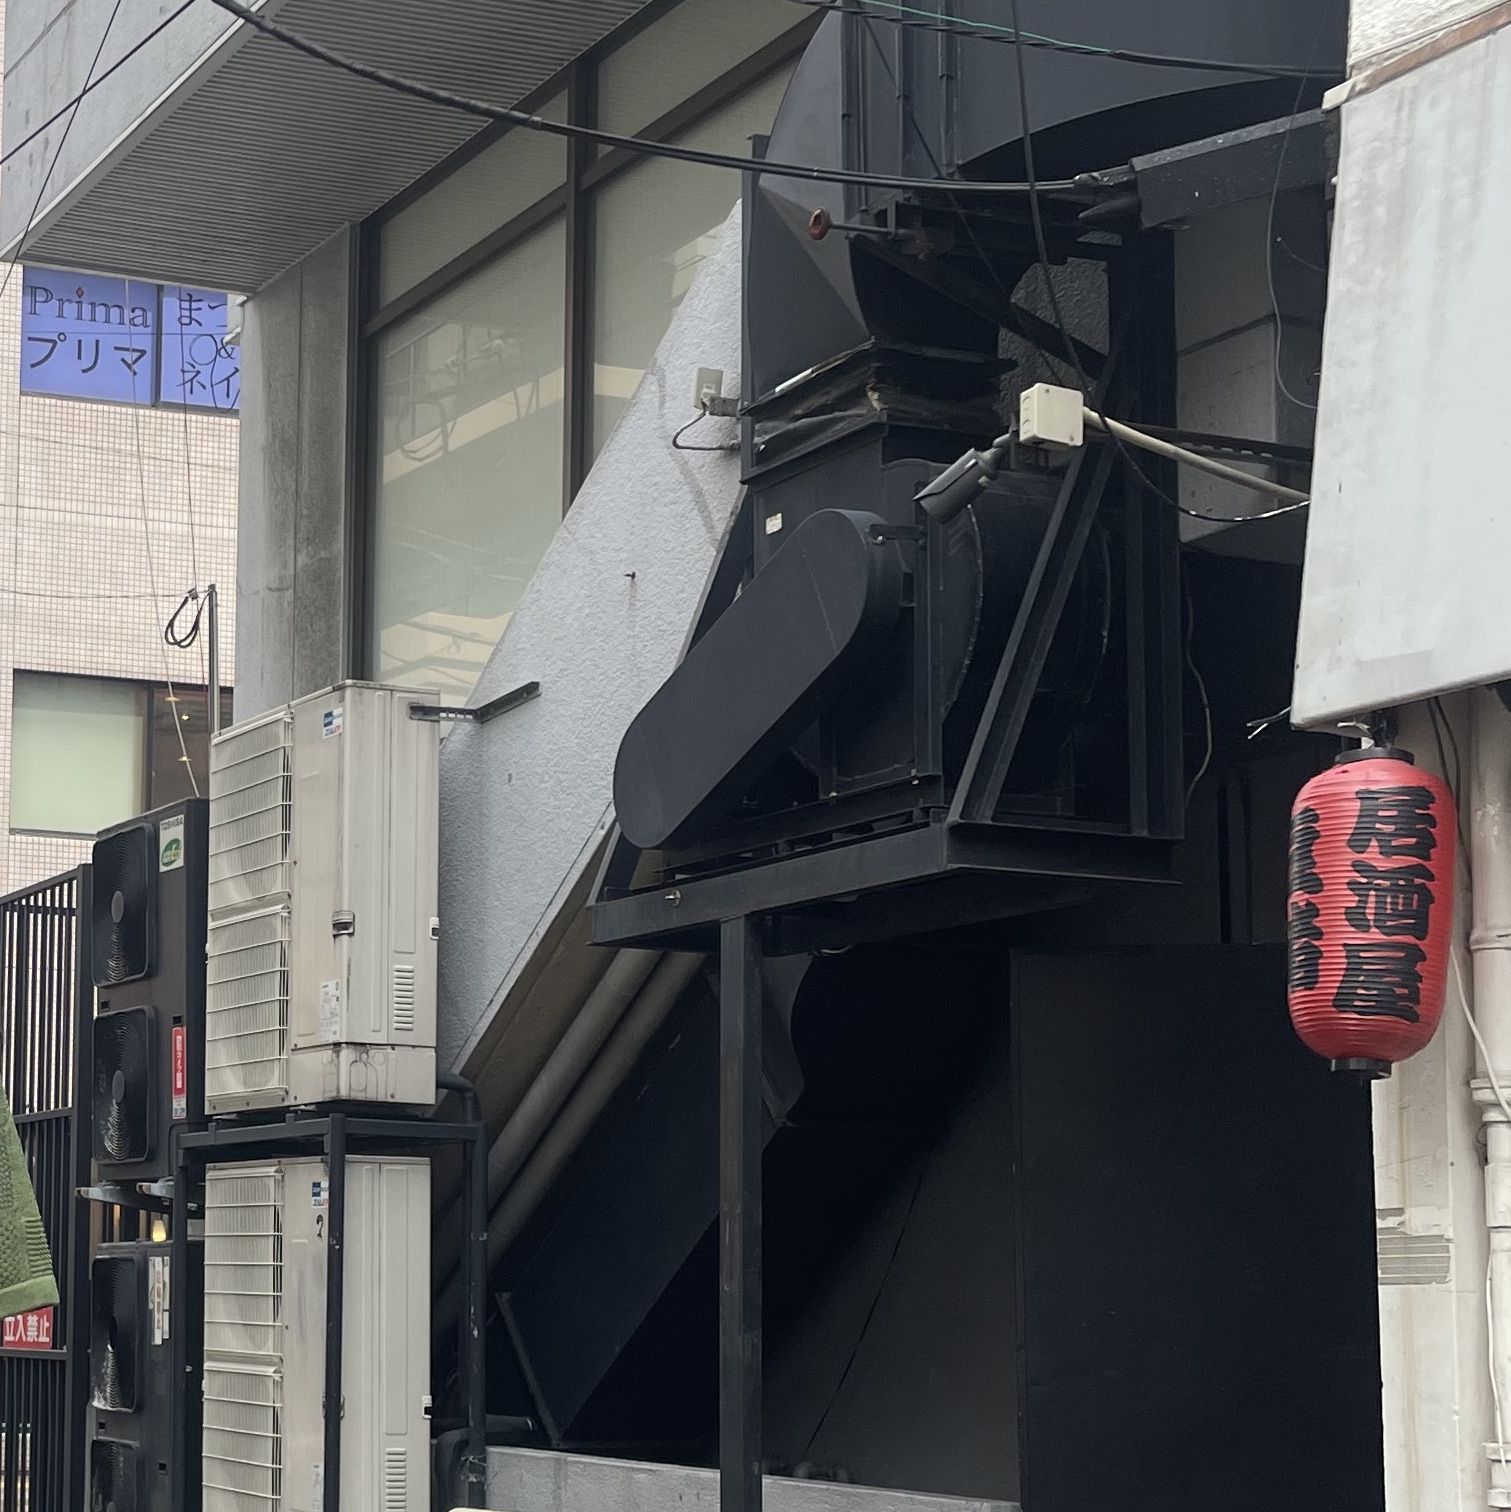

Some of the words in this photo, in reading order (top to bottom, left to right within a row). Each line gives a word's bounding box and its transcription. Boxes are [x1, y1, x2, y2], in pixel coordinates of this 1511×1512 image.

[28, 285, 151, 328] Prima
[27, 333, 147, 376] プリマ
[1332, 786, 1437, 1023] 居酒屋
[4, 1314, 50, 1342] 立入禁止
